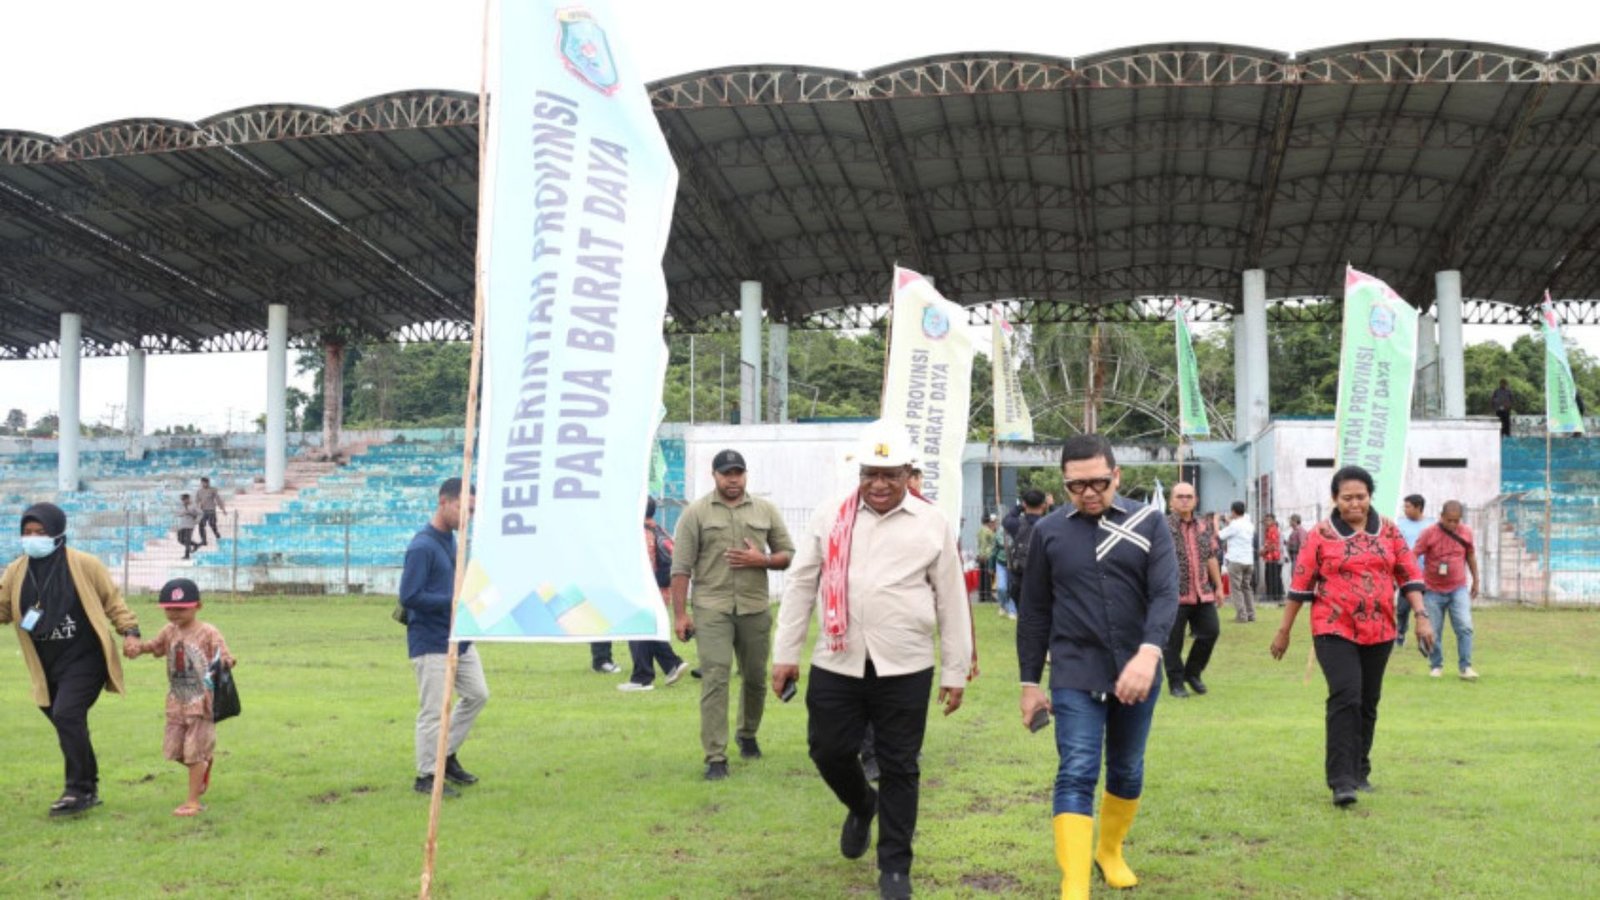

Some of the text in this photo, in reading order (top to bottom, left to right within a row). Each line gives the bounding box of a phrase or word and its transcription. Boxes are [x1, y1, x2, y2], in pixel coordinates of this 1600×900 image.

[501, 89, 579, 536] PEMERINTAH PROVINSI
[553, 136, 629, 500] PAPUA BARAT DAYA
[906, 348, 929, 420] PROVINSI
[1351, 346, 1376, 413] PROVINSI
[1374, 360, 1392, 399] DAYA
[924, 362, 949, 501] APUA BARAT DAYA
[1367, 401, 1390, 450] BARAT
